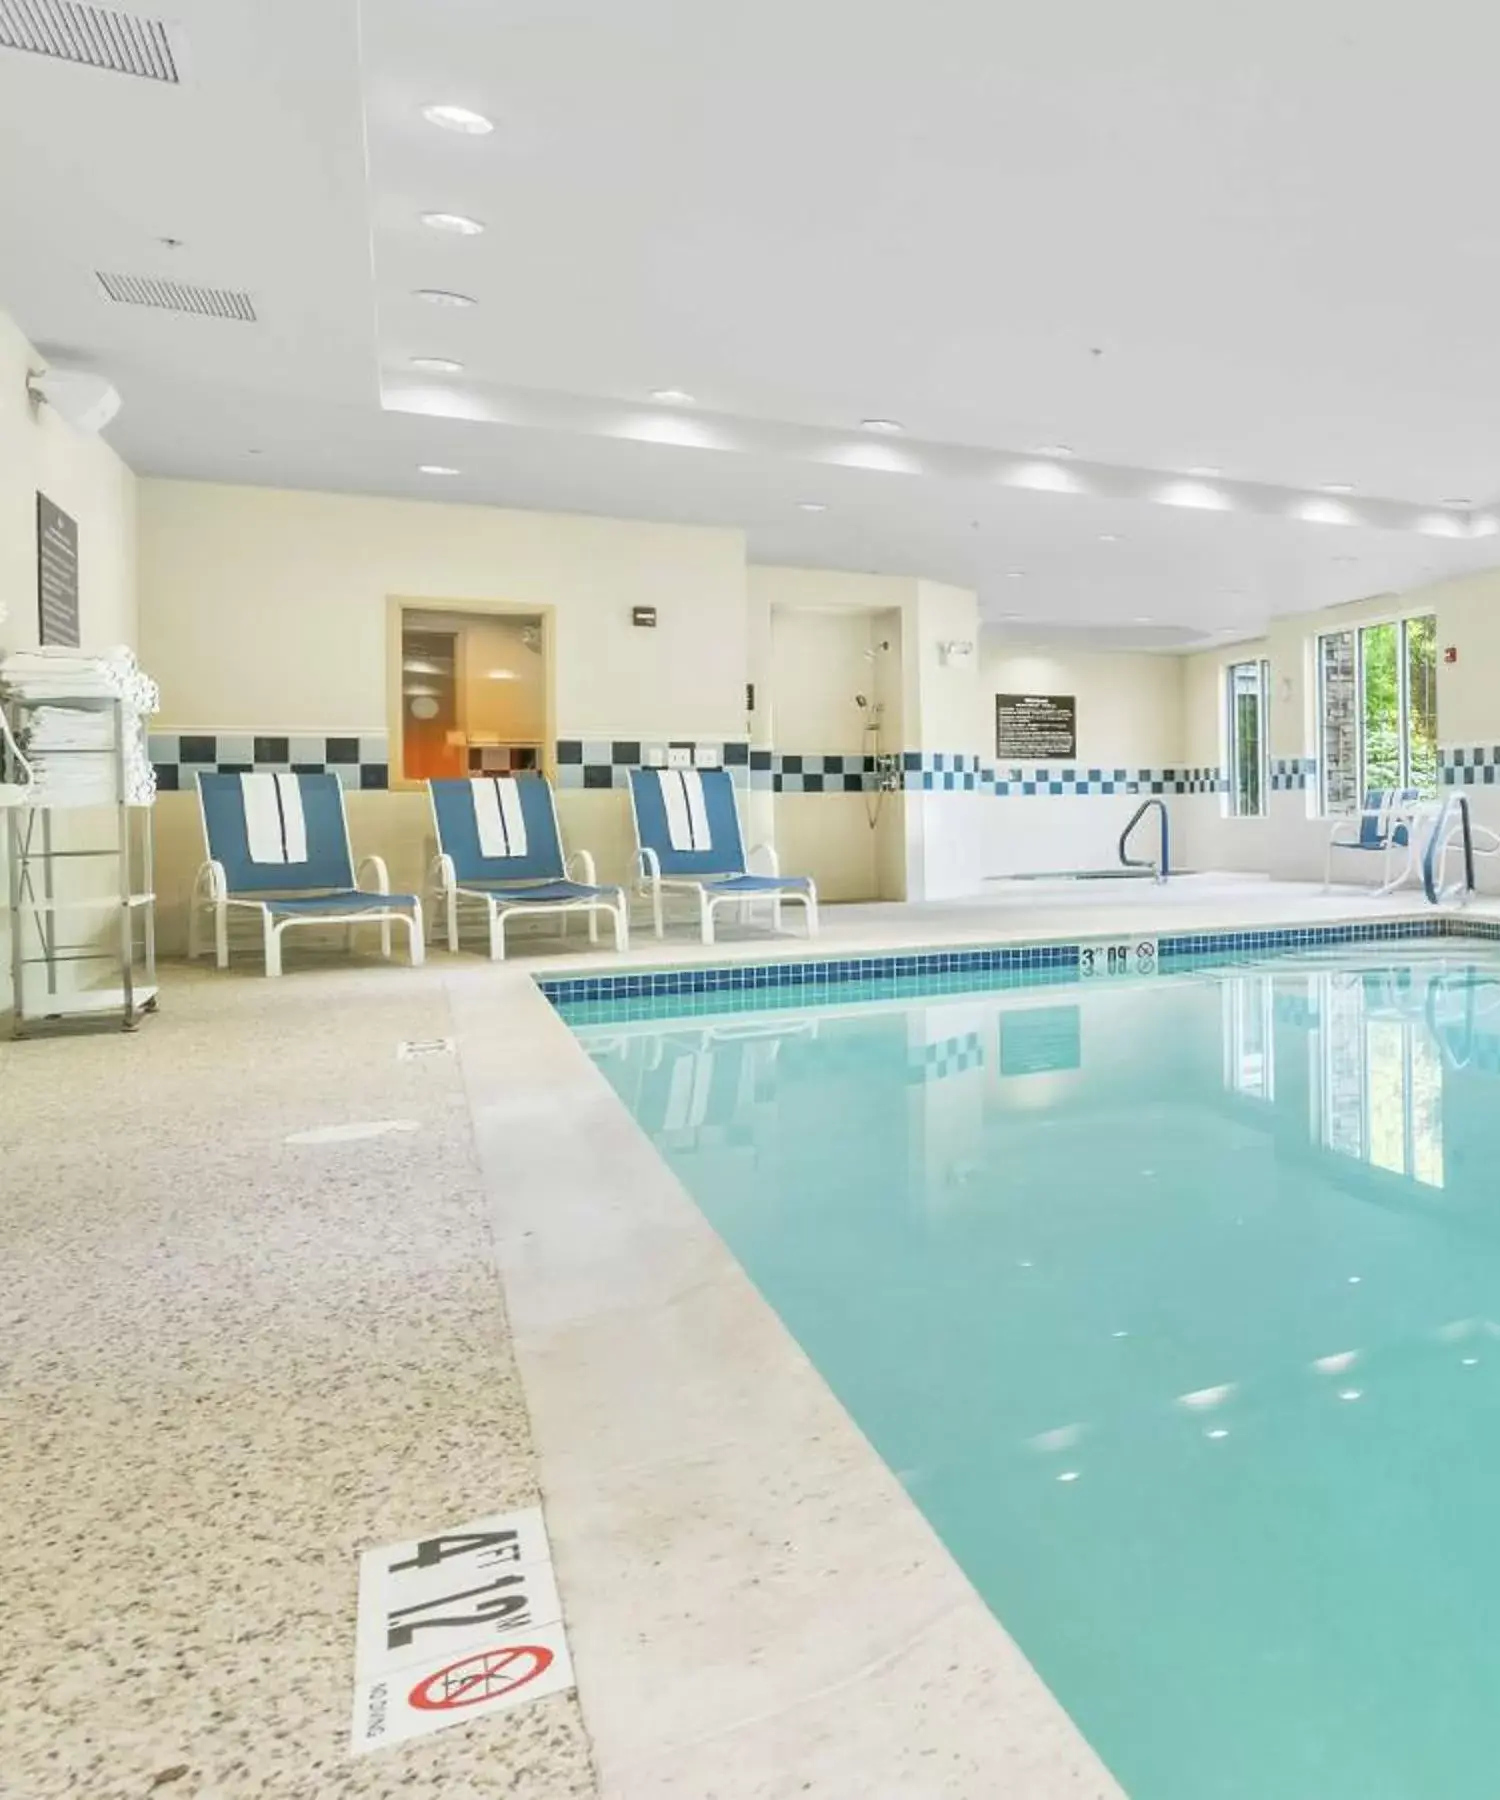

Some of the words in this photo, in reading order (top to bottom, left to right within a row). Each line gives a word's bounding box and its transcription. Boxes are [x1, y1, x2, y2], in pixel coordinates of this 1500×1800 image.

[388, 1529, 518, 1573] 4
[477, 1543, 521, 1569] FT
[367, 1698, 386, 1738] DIVING
